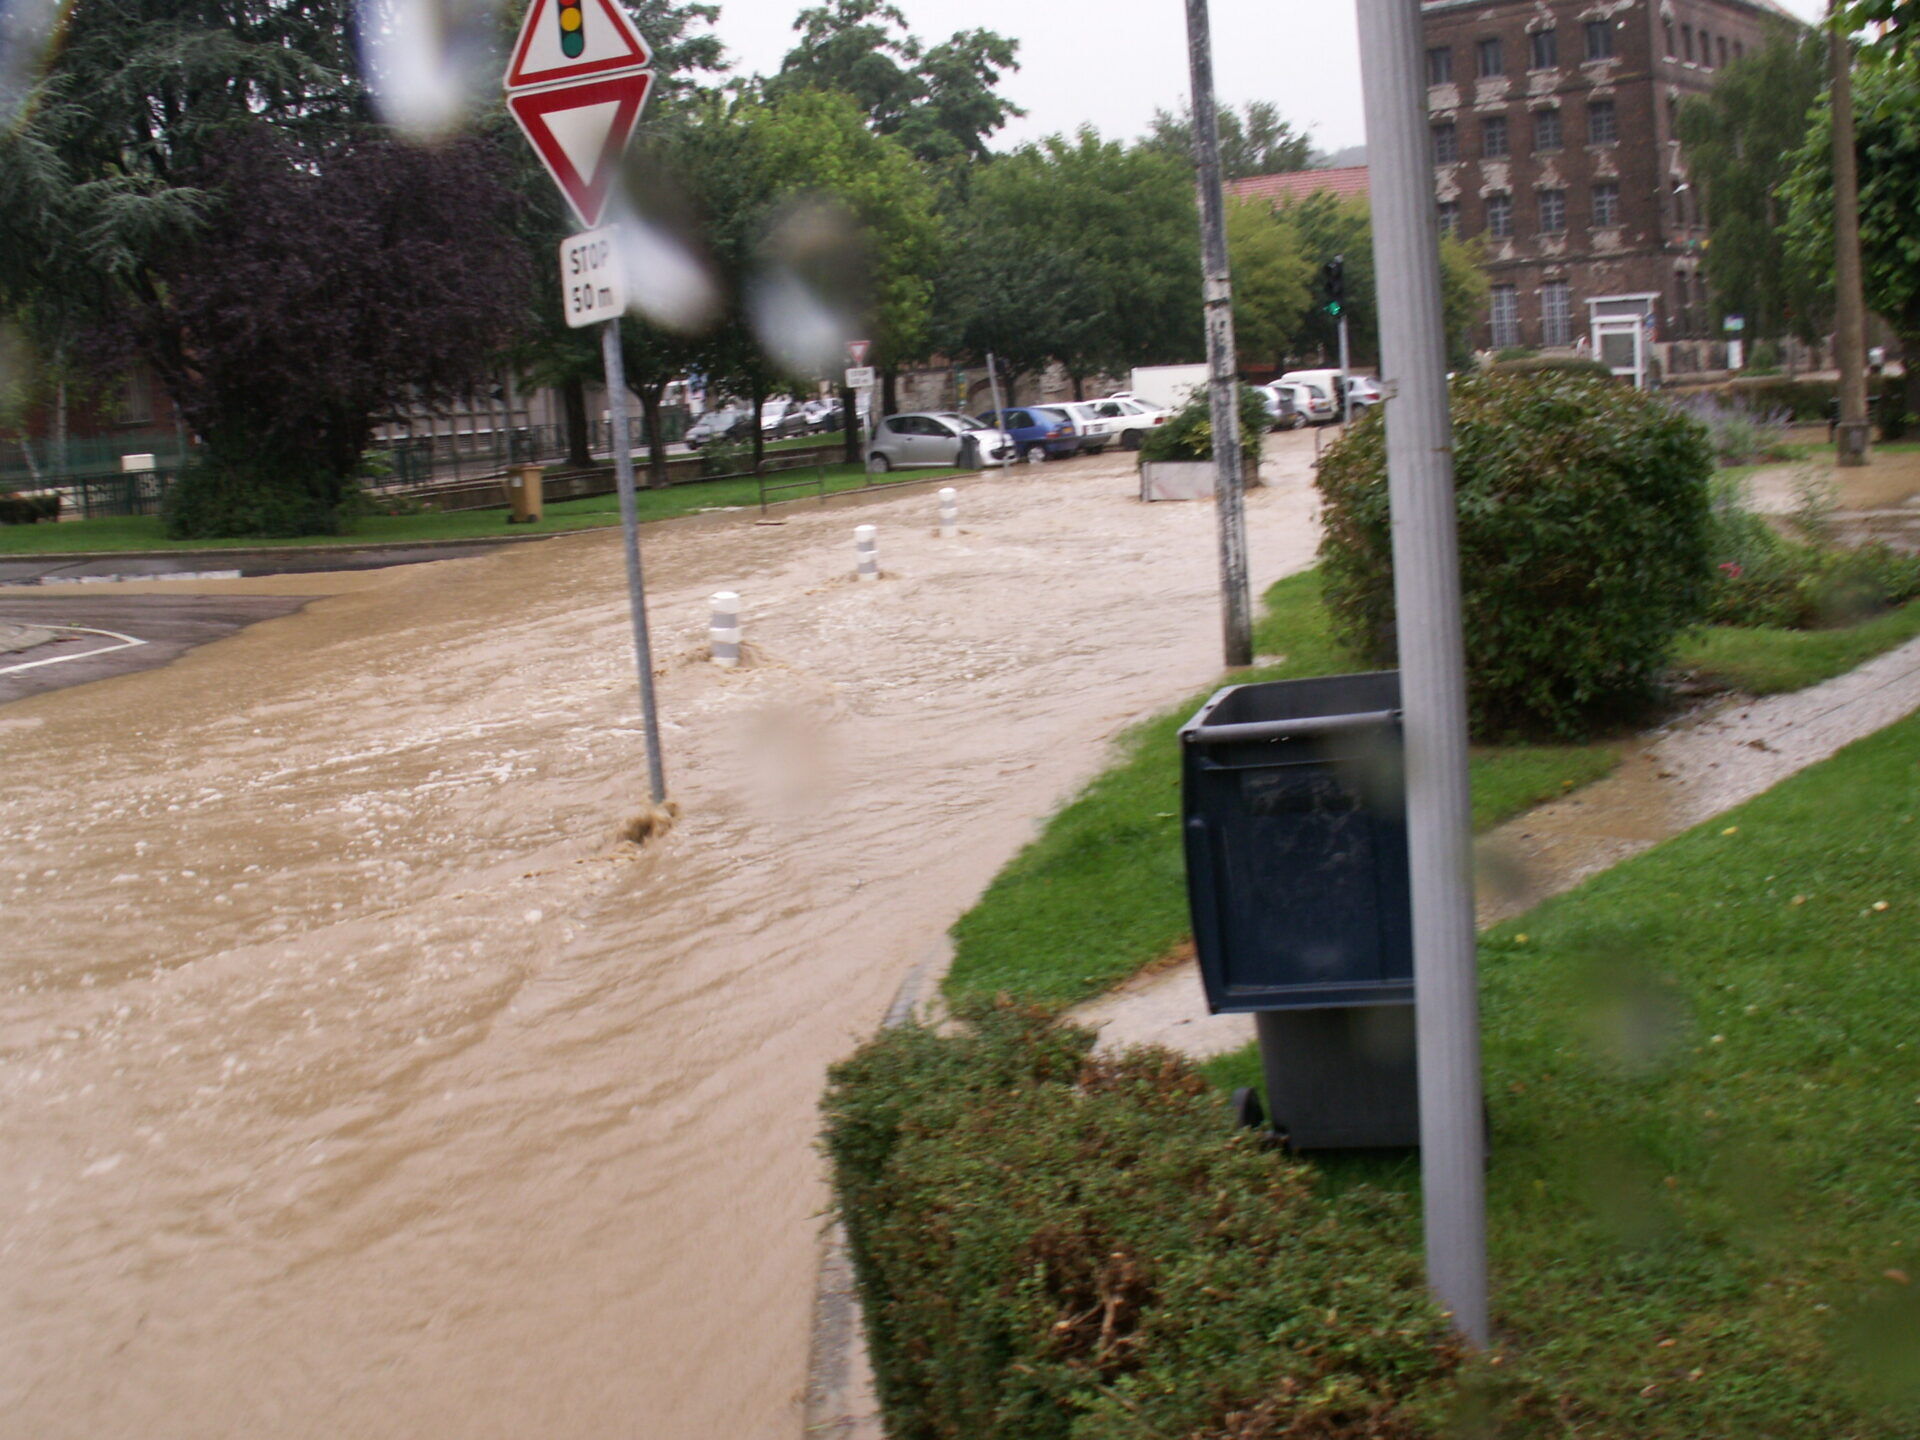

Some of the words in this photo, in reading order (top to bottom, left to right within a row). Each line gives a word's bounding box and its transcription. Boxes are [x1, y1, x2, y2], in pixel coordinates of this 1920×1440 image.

[571, 240, 609, 275] STOP
[573, 283, 593, 312] 50
[598, 287, 613, 307] m
